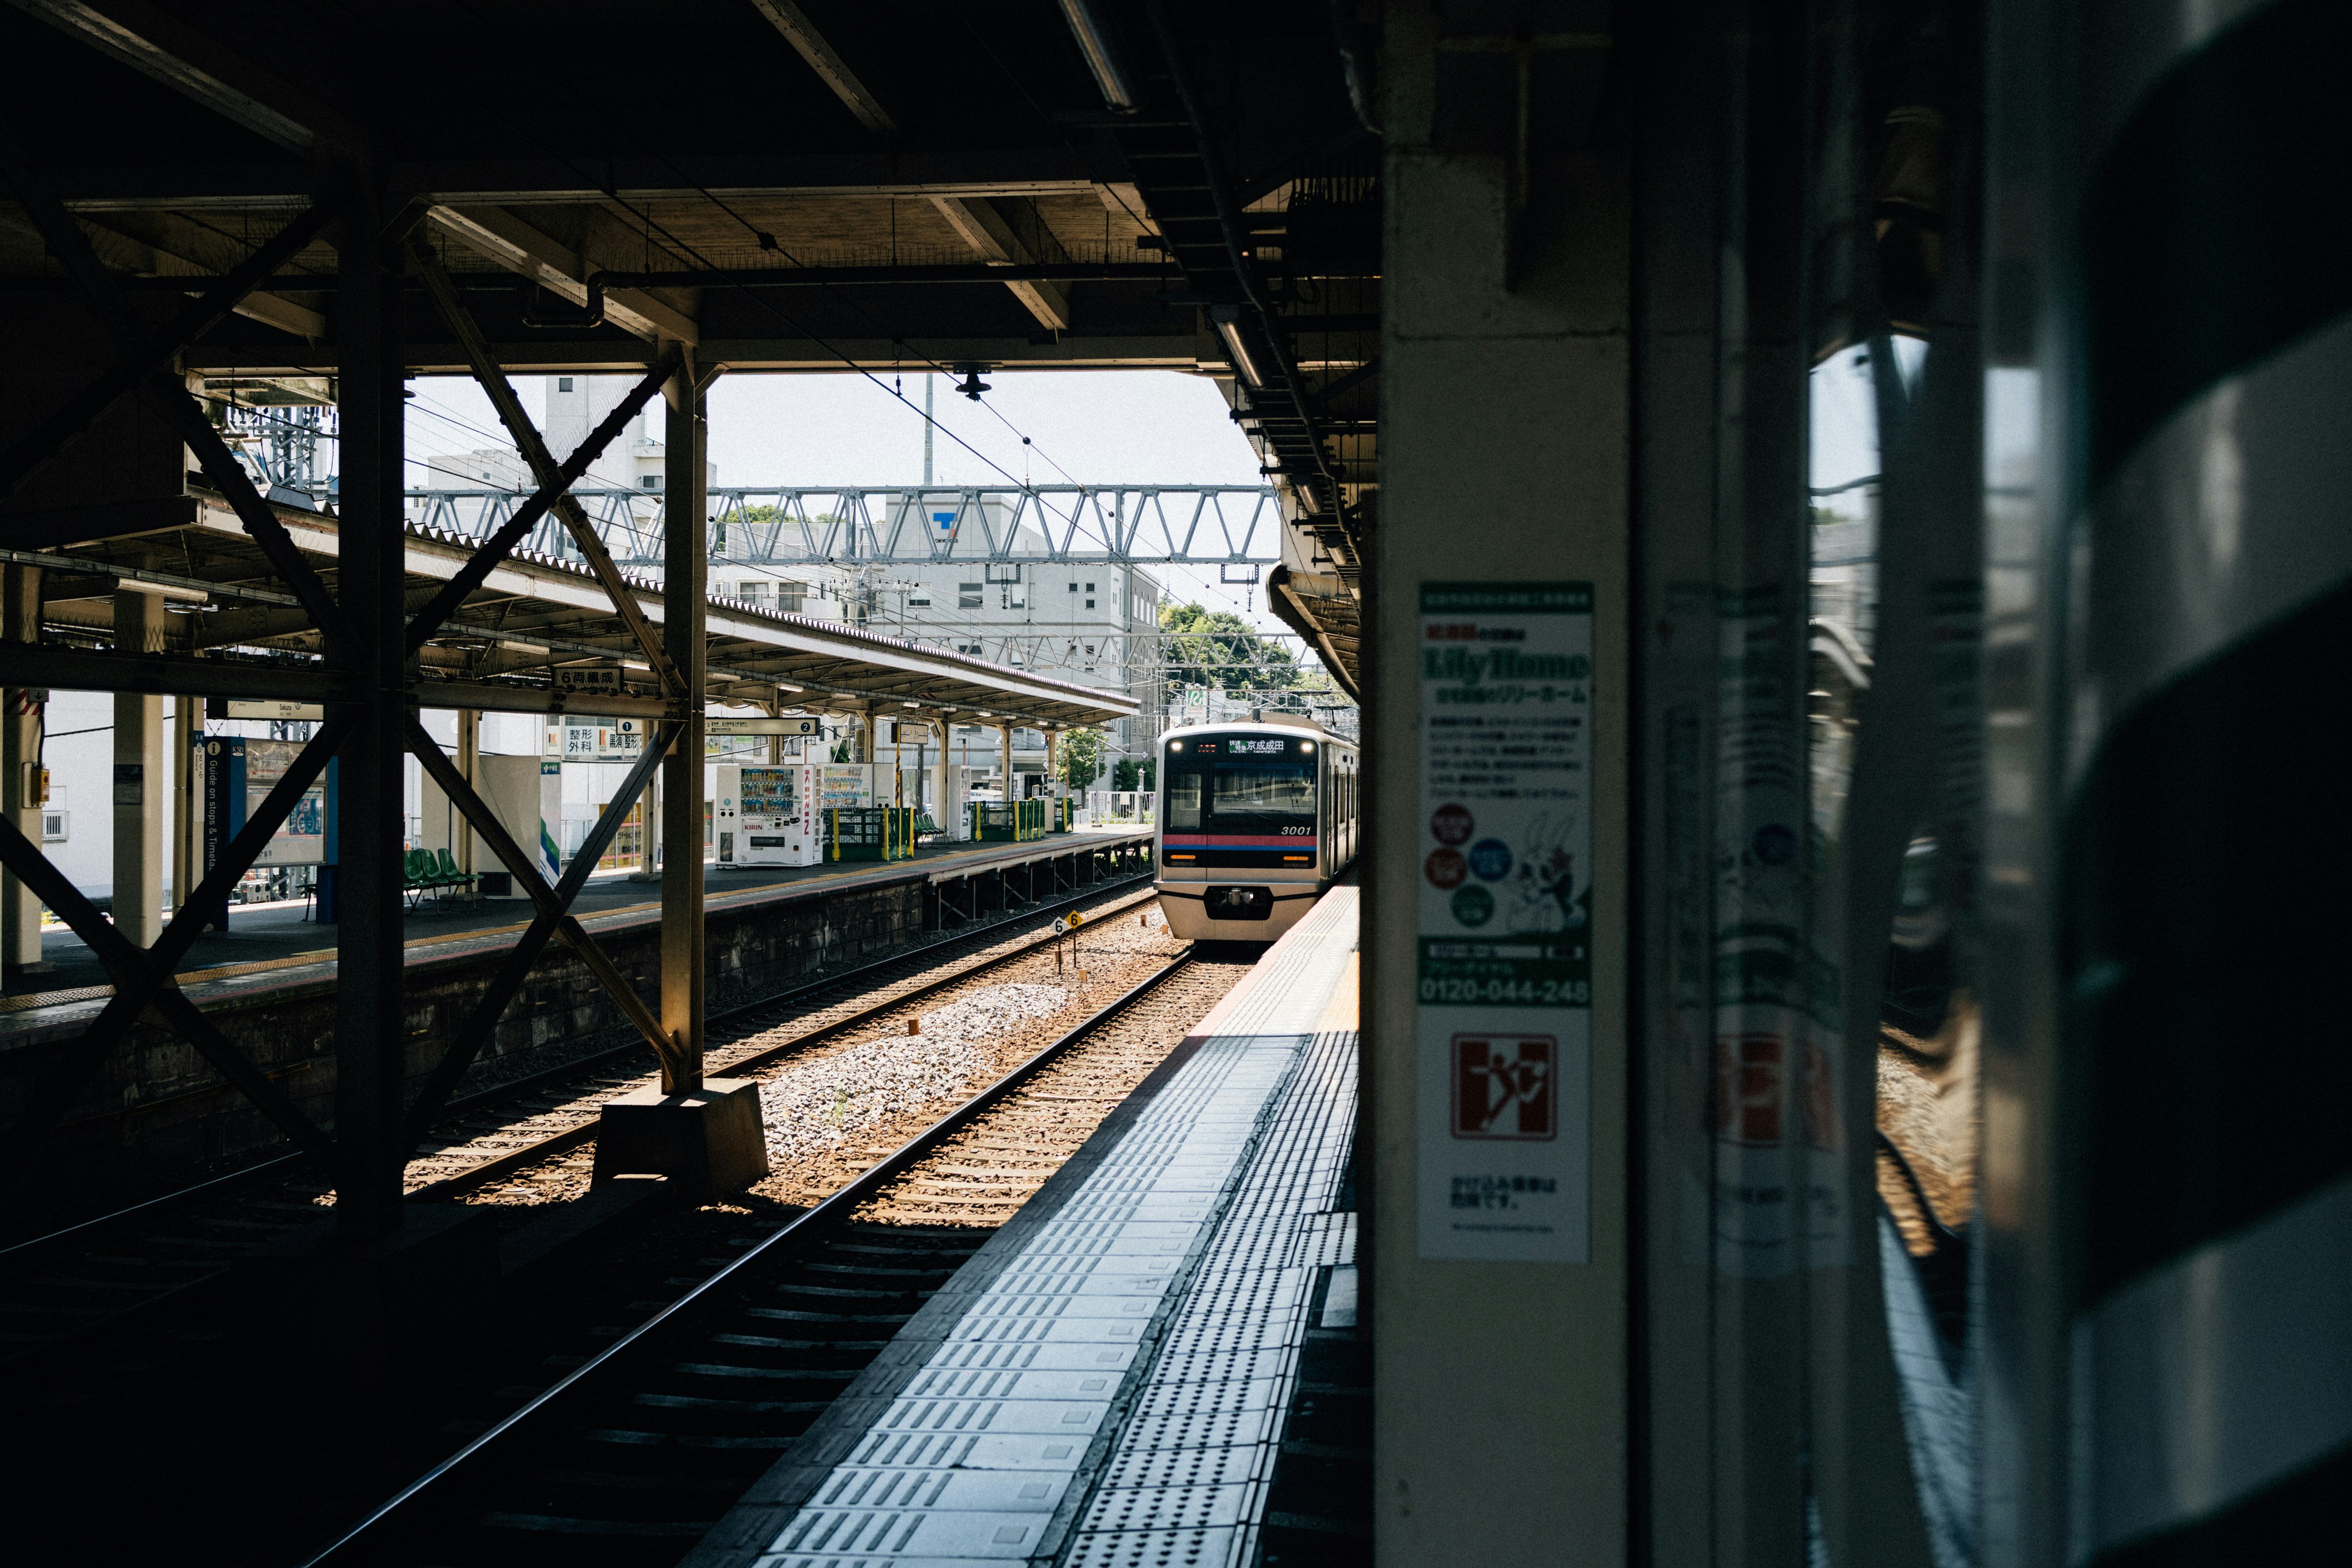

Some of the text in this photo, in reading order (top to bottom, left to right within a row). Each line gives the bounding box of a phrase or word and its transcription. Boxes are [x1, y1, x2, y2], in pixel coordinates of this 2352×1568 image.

[561, 672, 613, 684] 6両編成
[569, 729, 592, 740] 整形
[569, 741, 591, 753] 外科
[1246, 740, 1284, 750] 京成成田
[209, 760, 218, 785] Guide
[209, 788, 215, 799] on
[207, 802, 217, 825] stops
[1281, 826, 1311, 835] 3001
[1056, 920, 1063, 932] 6
[1071, 914, 1077, 926] 6
[1421, 978, 1589, 1003] 0120-044-248
